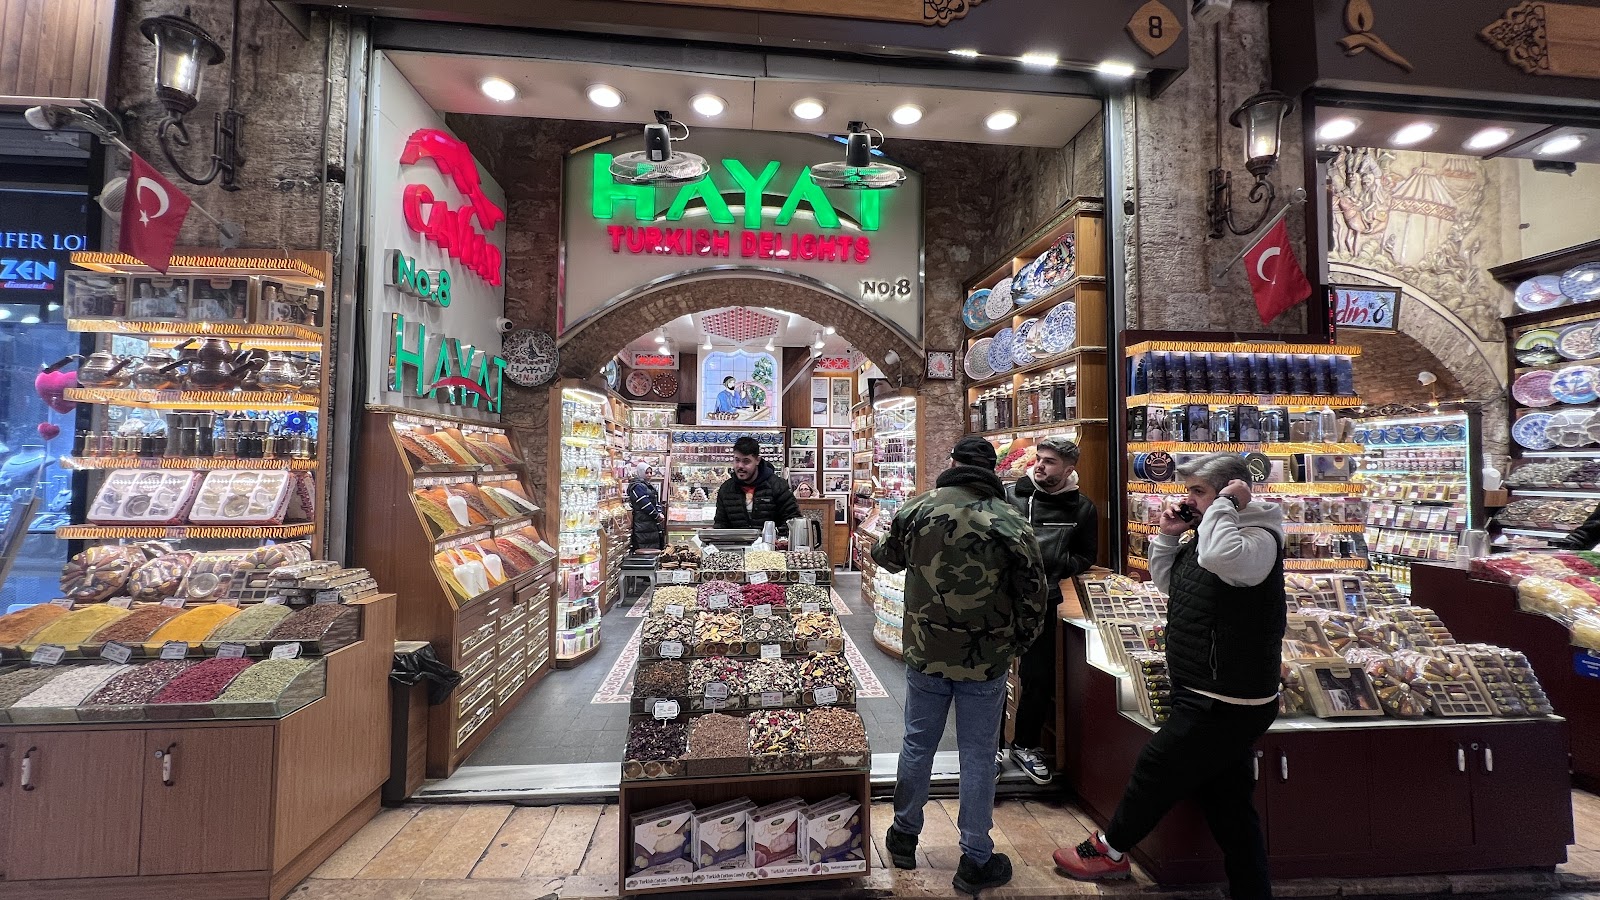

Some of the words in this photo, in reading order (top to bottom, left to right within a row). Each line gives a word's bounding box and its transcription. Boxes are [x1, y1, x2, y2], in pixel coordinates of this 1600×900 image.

[1148, 15, 1163, 39] 8
[591, 152, 880, 231] HAYAT
[53, 234, 87, 251] LO
[606, 225, 730, 257] TURKISH
[741, 231, 871, 263] DELIGHTS
[0, 259, 57, 281] ZEN
[4, 281, 47, 290] diamond
[393, 313, 507, 414] HAYAT
[511, 364, 548, 375] HAYAT
[1146, 452, 1172, 465] CAVIAR
